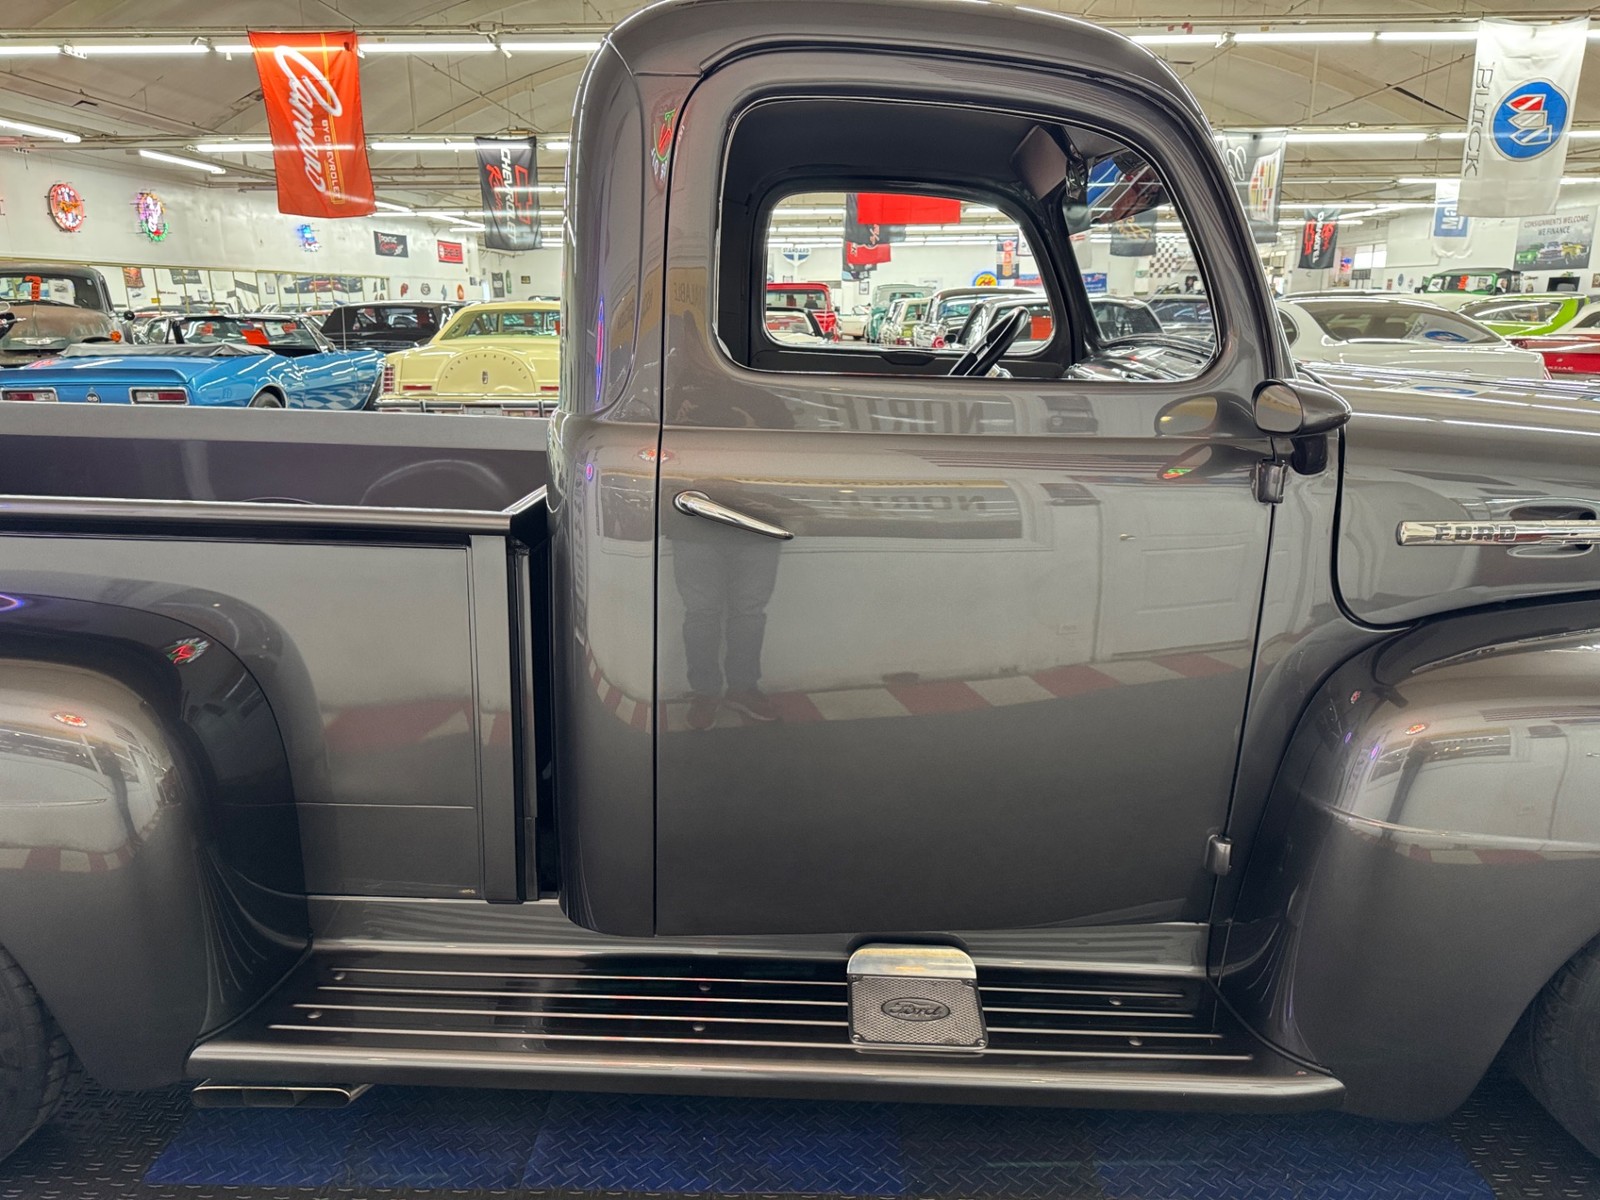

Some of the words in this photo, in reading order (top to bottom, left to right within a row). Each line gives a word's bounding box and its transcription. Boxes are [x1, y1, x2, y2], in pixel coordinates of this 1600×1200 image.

[273, 45, 342, 193] Camaro
[321, 119, 330, 133] BY
[1464, 61, 1495, 177] BUICK
[323, 134, 342, 200] CHEVROLET
[501, 147, 517, 244] CHEVROLET
[1524, 218, 1561, 228] CONSIGNMENTS
[1563, 214, 1590, 224] WELCOME
[1538, 228, 1546, 236] WE
[1547, 225, 1571, 235] FINANCE
[1435, 524, 1517, 541] FORD
[889, 1000, 942, 1017] Ford
